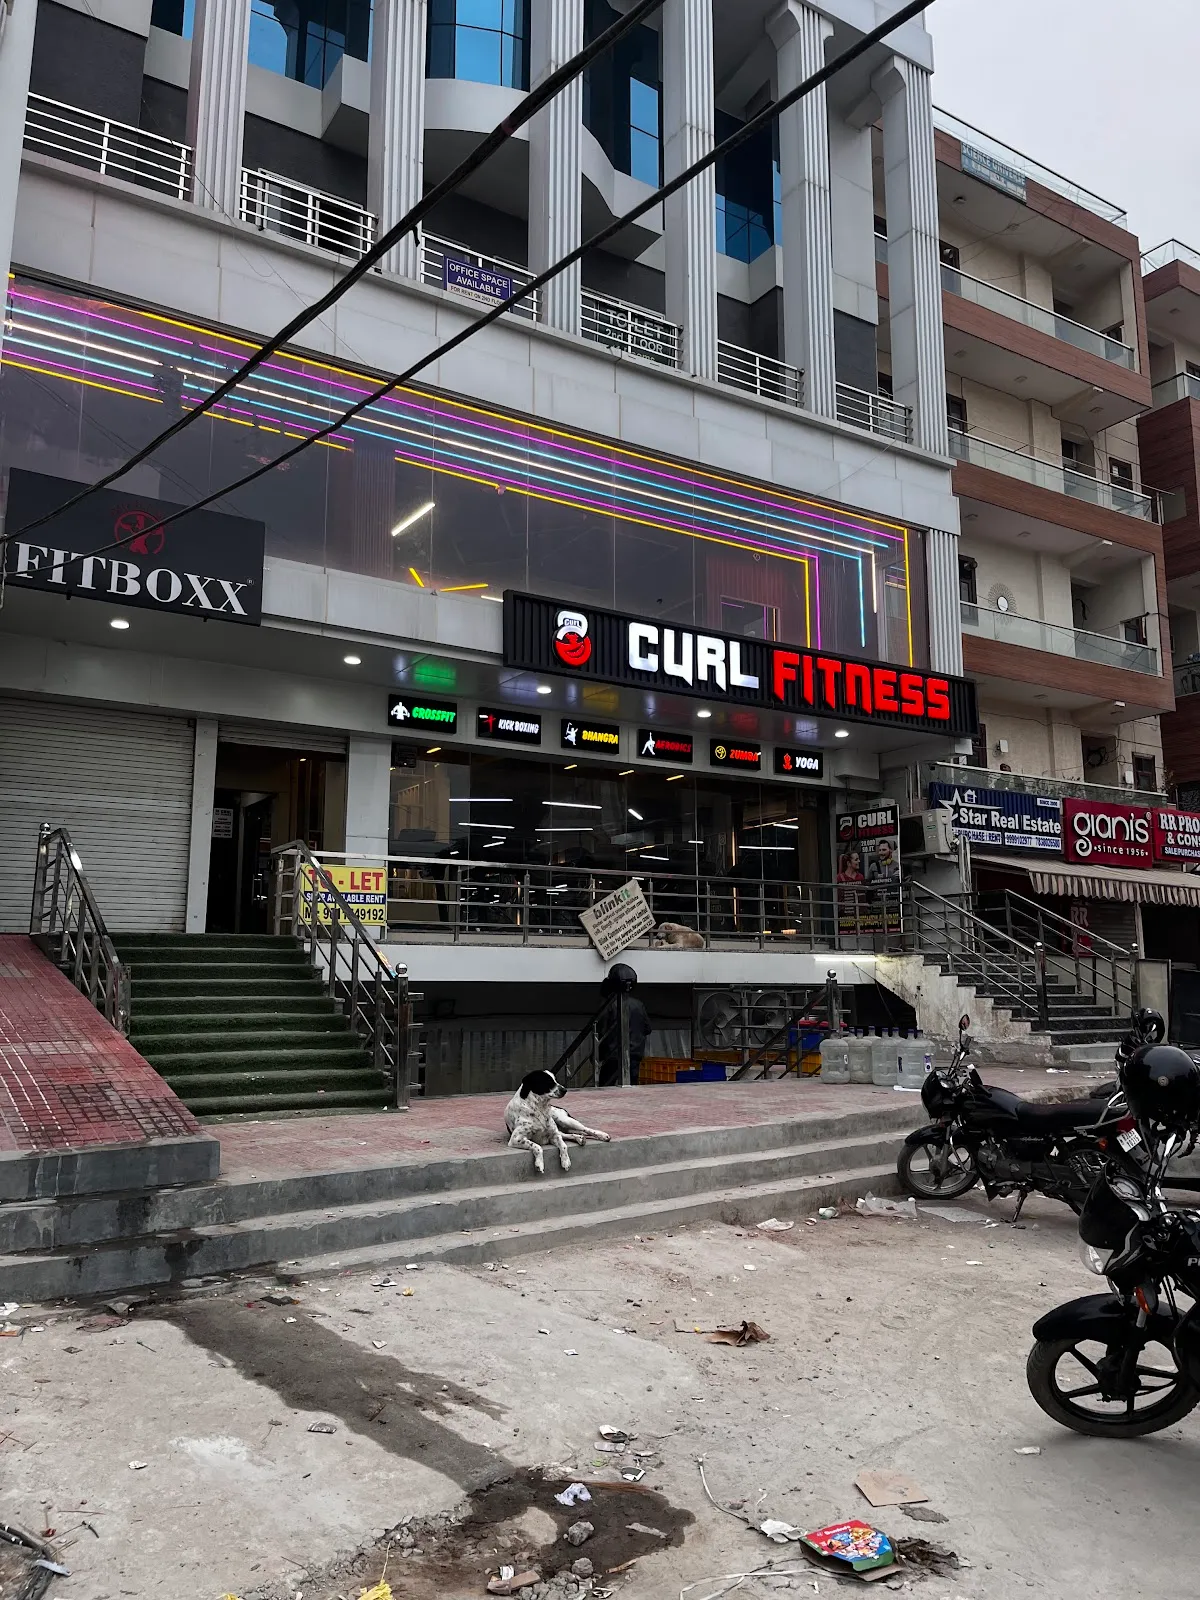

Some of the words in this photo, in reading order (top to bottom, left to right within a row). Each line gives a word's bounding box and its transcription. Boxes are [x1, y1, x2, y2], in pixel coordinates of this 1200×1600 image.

[449, 263, 479, 280] OFFICE
[481, 270, 508, 288] SPACE
[450, 286, 460, 294] FOR
[461, 288, 473, 298] RENT
[456, 275, 502, 296] AVAILABLE
[15, 542, 248, 616] FITBOXX
[628, 621, 760, 695] CURL
[772, 648, 950, 720] FITNESS
[412, 706, 456, 723] CROSSFIT
[498, 719, 514, 732] KICK
[514, 721, 539, 735] BOXING
[582, 730, 619, 745] BHANGRA
[730, 749, 759, 762] ZUMBA
[795, 756, 819, 770] YOGA
[857, 810, 894, 828] CURL
[960, 808, 988, 826] Star
[991, 810, 1019, 830] Real
[1022, 814, 1061, 834] Estate
[1160, 813, 1177, 831] RR
[858, 825, 894, 839] FITNESS
[1167, 832, 1175, 845] &
[1098, 843, 1124, 854] since
[1126, 848, 1145, 856] 1956
[350, 872, 383, 890] LET
[366, 894, 384, 904] RENT
[593, 888, 630, 920] blinkit
[1070, 906, 1089, 927] RR
